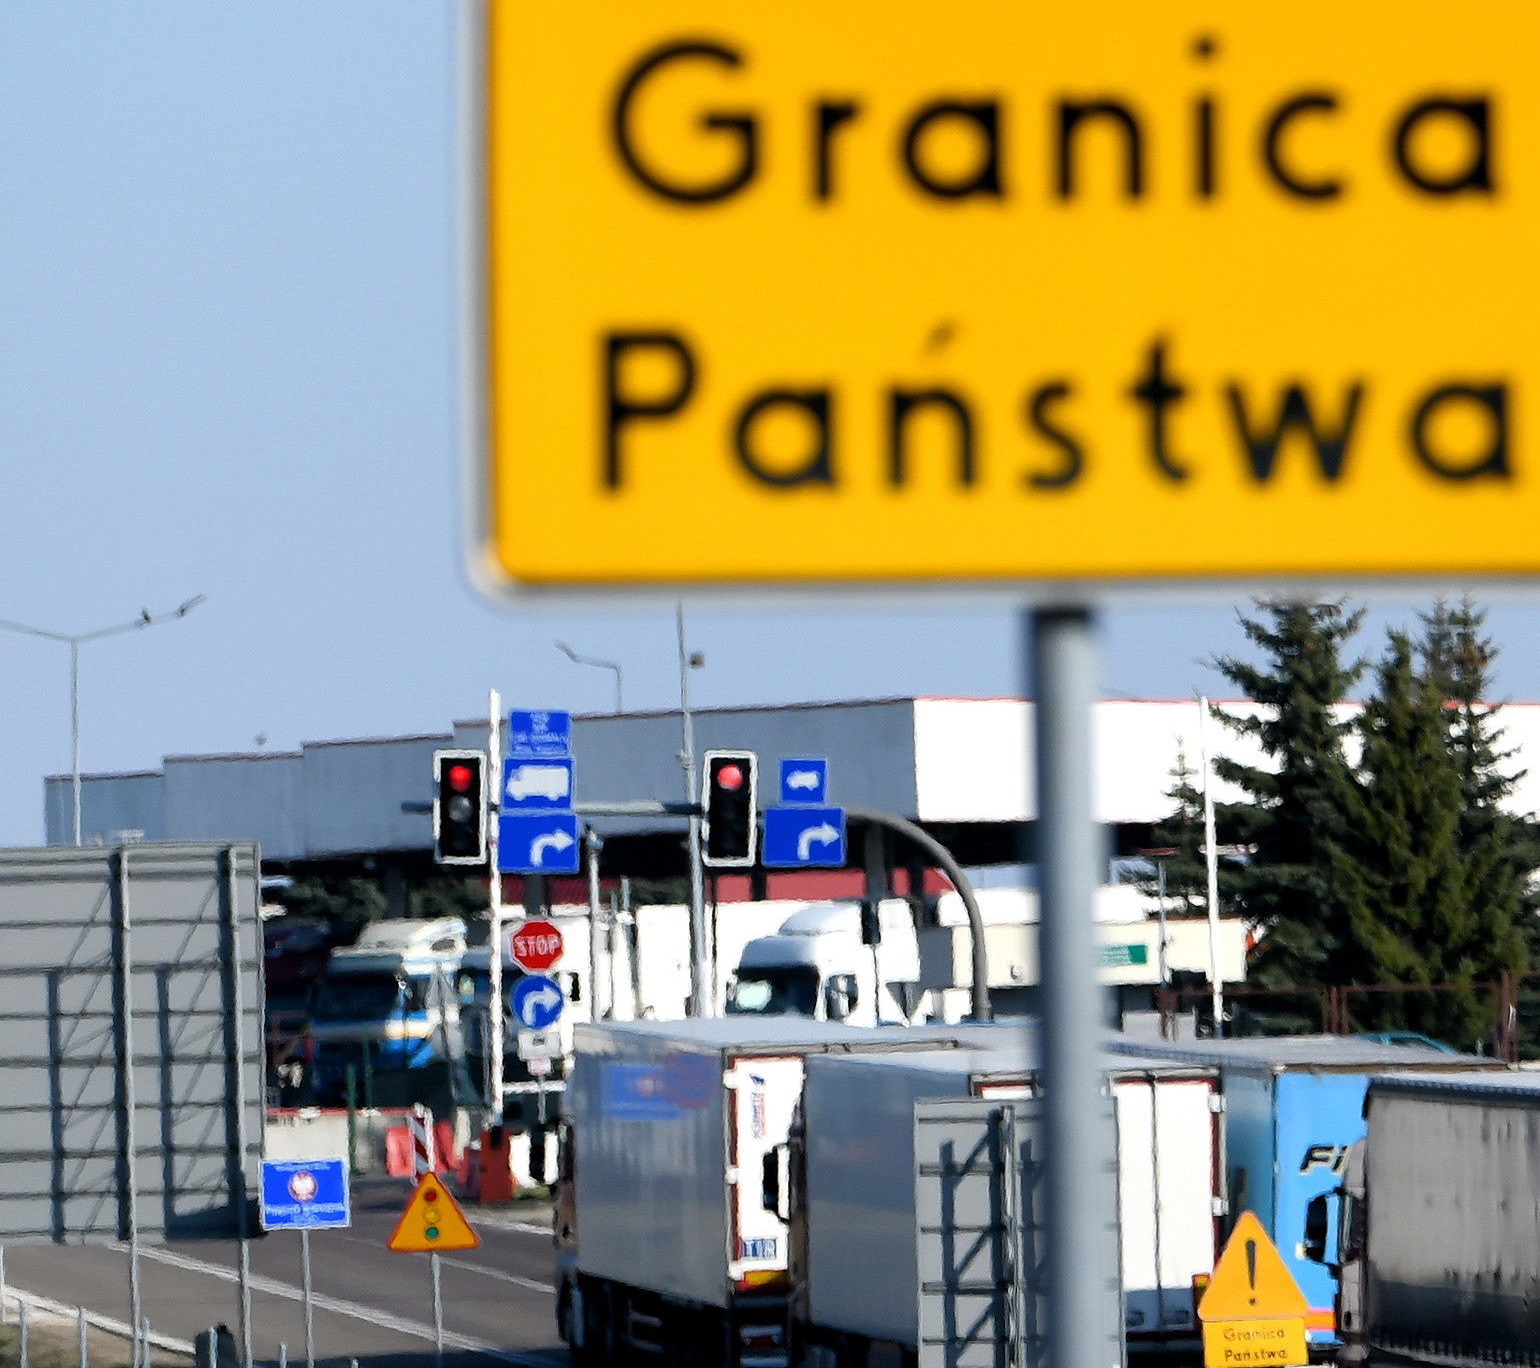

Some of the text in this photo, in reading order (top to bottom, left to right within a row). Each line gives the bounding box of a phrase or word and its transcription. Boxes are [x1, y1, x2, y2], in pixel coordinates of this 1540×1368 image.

[606, 32, 1501, 209] Granica
[597, 317, 1520, 494] Państwa
[513, 935, 562, 957] STOP
